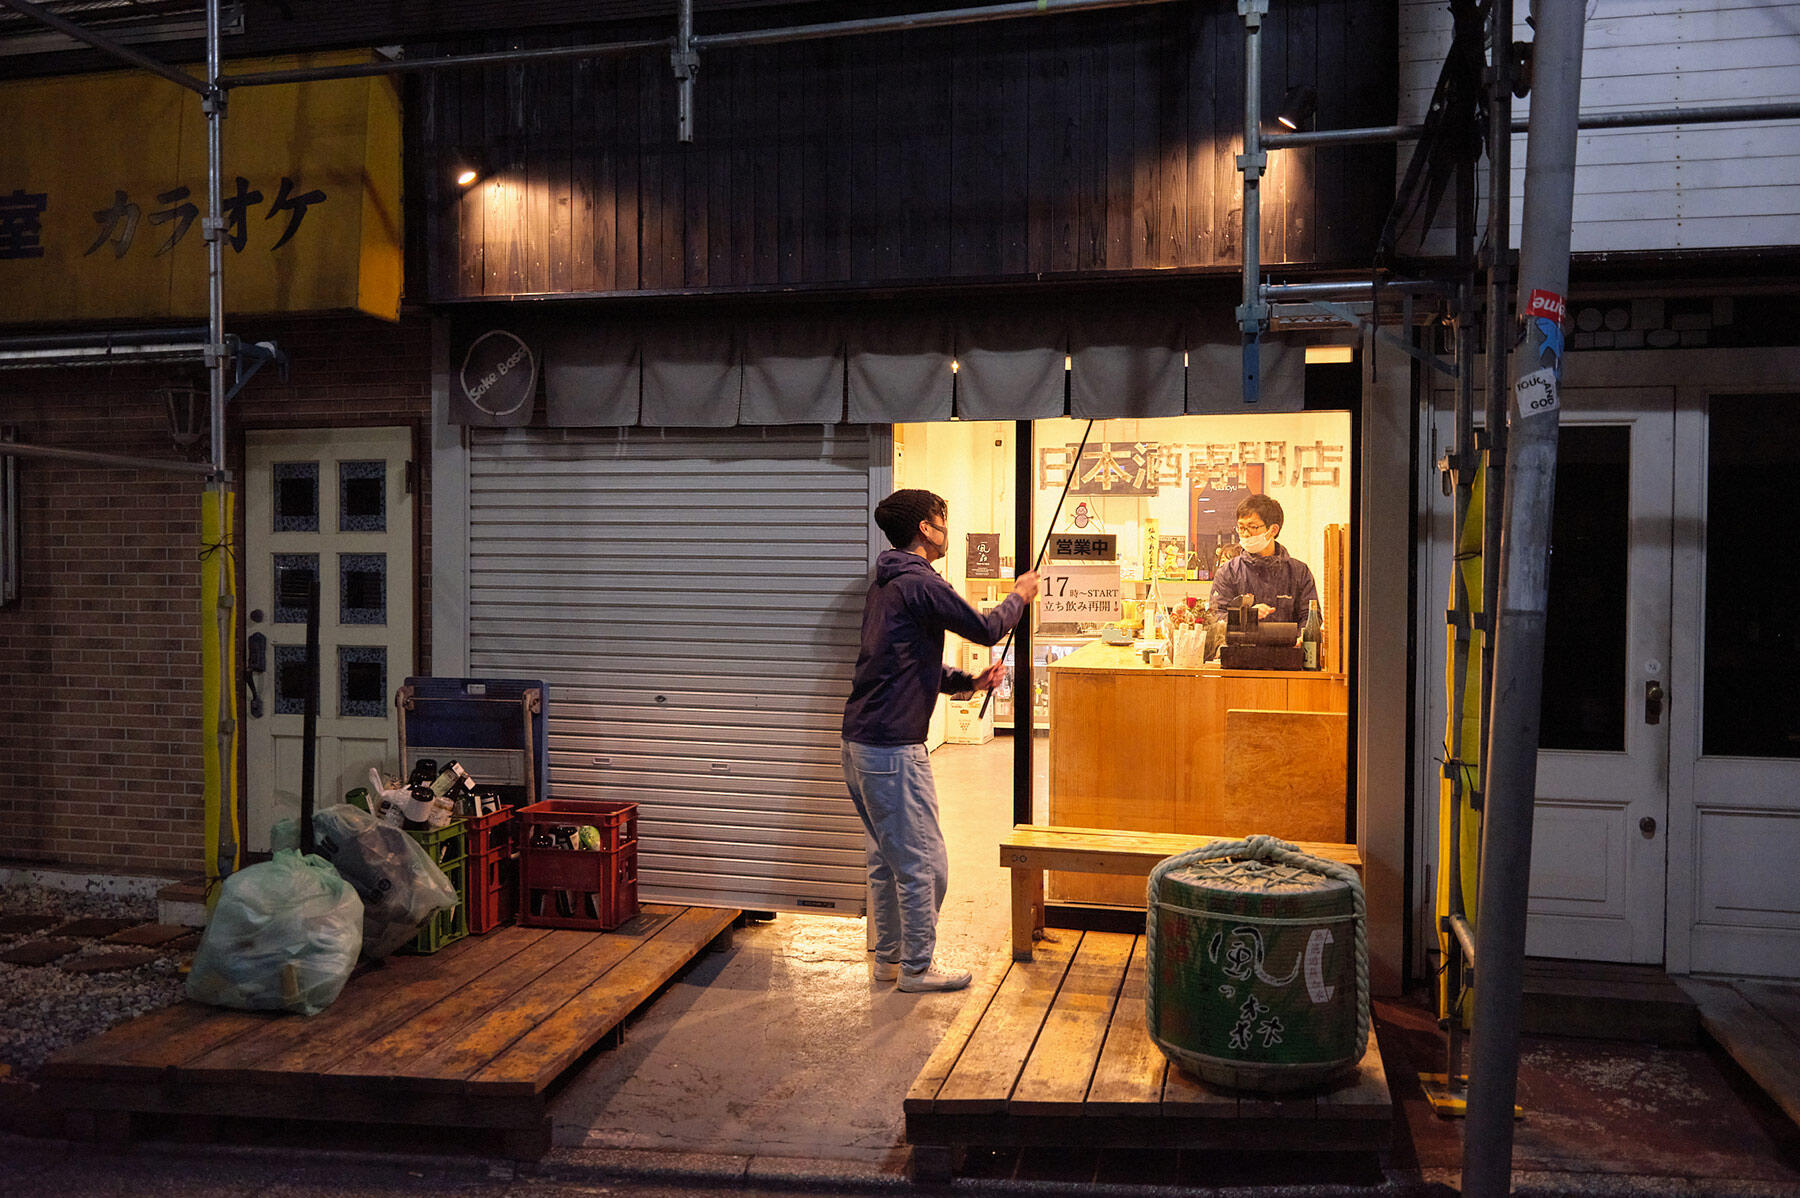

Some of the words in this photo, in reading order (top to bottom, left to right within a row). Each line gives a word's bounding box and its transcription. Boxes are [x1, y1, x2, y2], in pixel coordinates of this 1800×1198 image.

[83, 176, 327, 259] カラオケ
[1038, 440, 1344, 490] 日本酒専門店
[1056, 538, 1109, 556] 営業中
